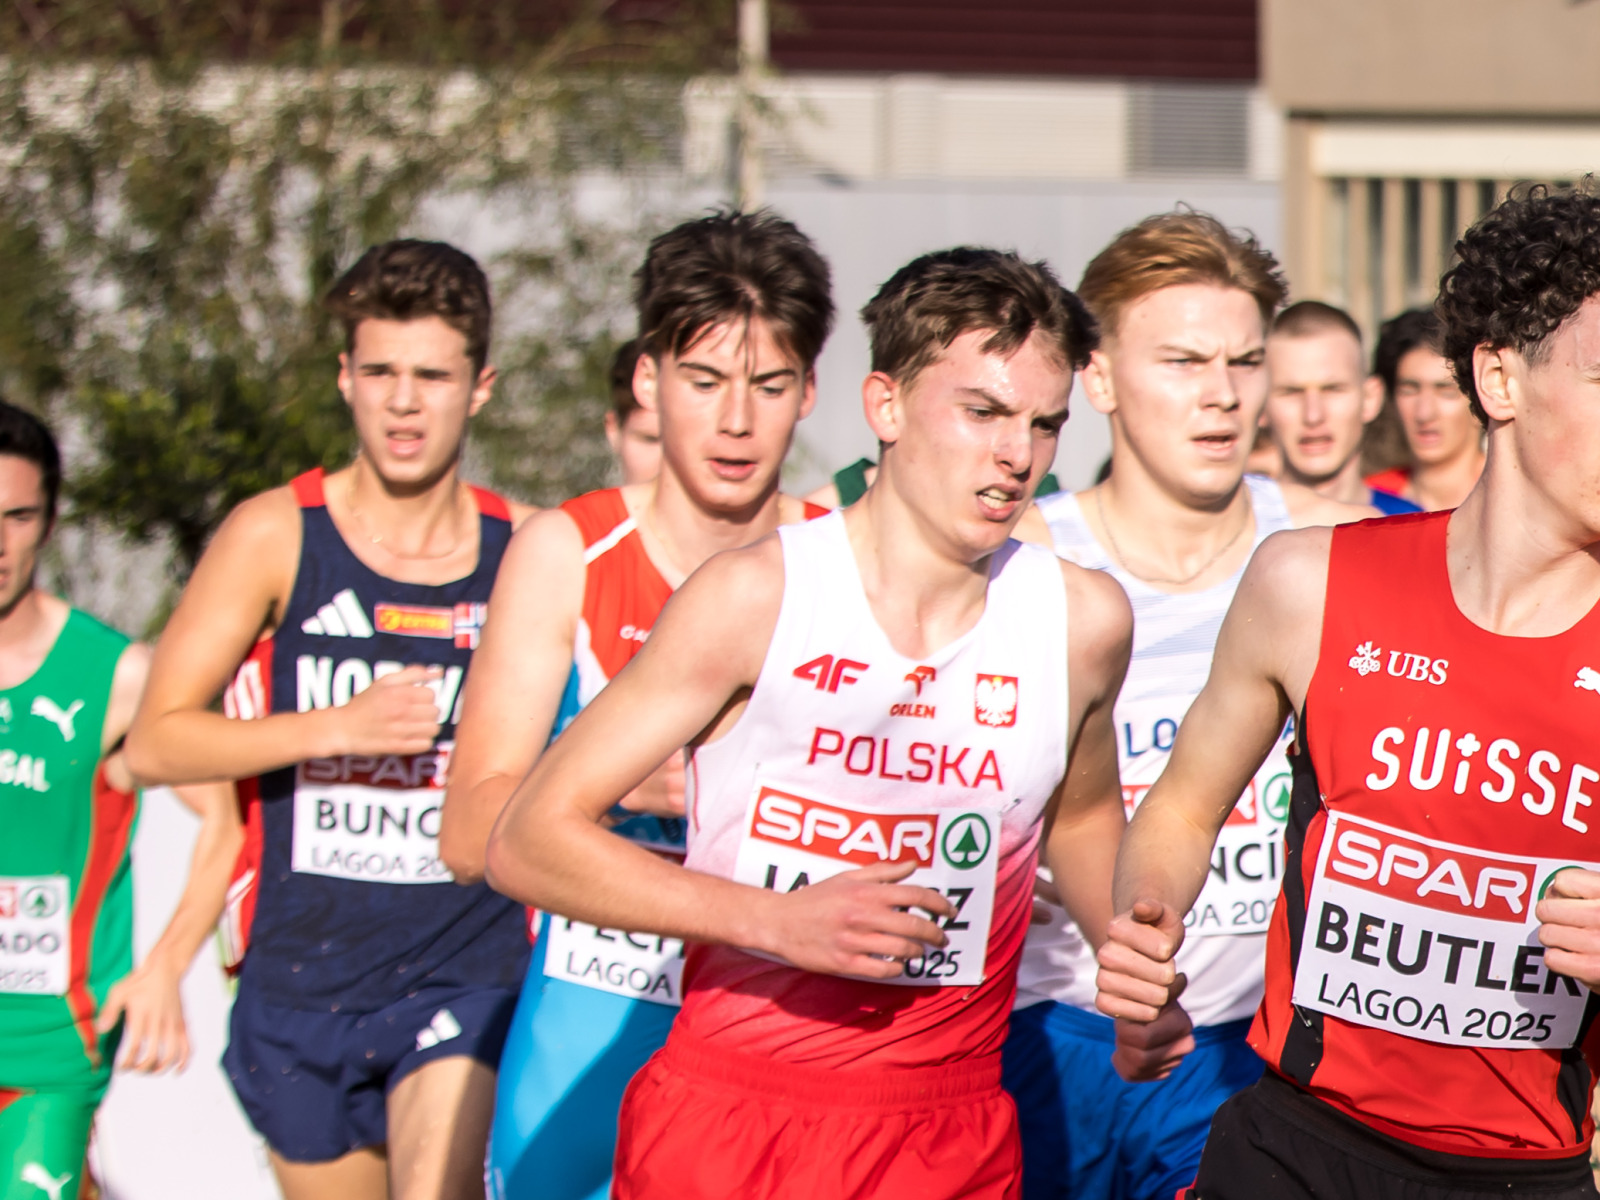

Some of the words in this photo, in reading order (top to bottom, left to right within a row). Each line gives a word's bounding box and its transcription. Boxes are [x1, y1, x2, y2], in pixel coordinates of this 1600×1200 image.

[793, 654, 870, 694] 4F
[1387, 650, 1449, 685] UBS
[889, 703, 935, 719] ORLEN
[807, 727, 1004, 792] POLSKA
[756, 796, 934, 861] SPAR
[311, 847, 405, 876] LAGOA
[1332, 830, 1528, 914] SPAR
[566, 951, 673, 999] LAGOA
[1318, 973, 1450, 1035] LAGOA
[1461, 1008, 1556, 1042] 2025
